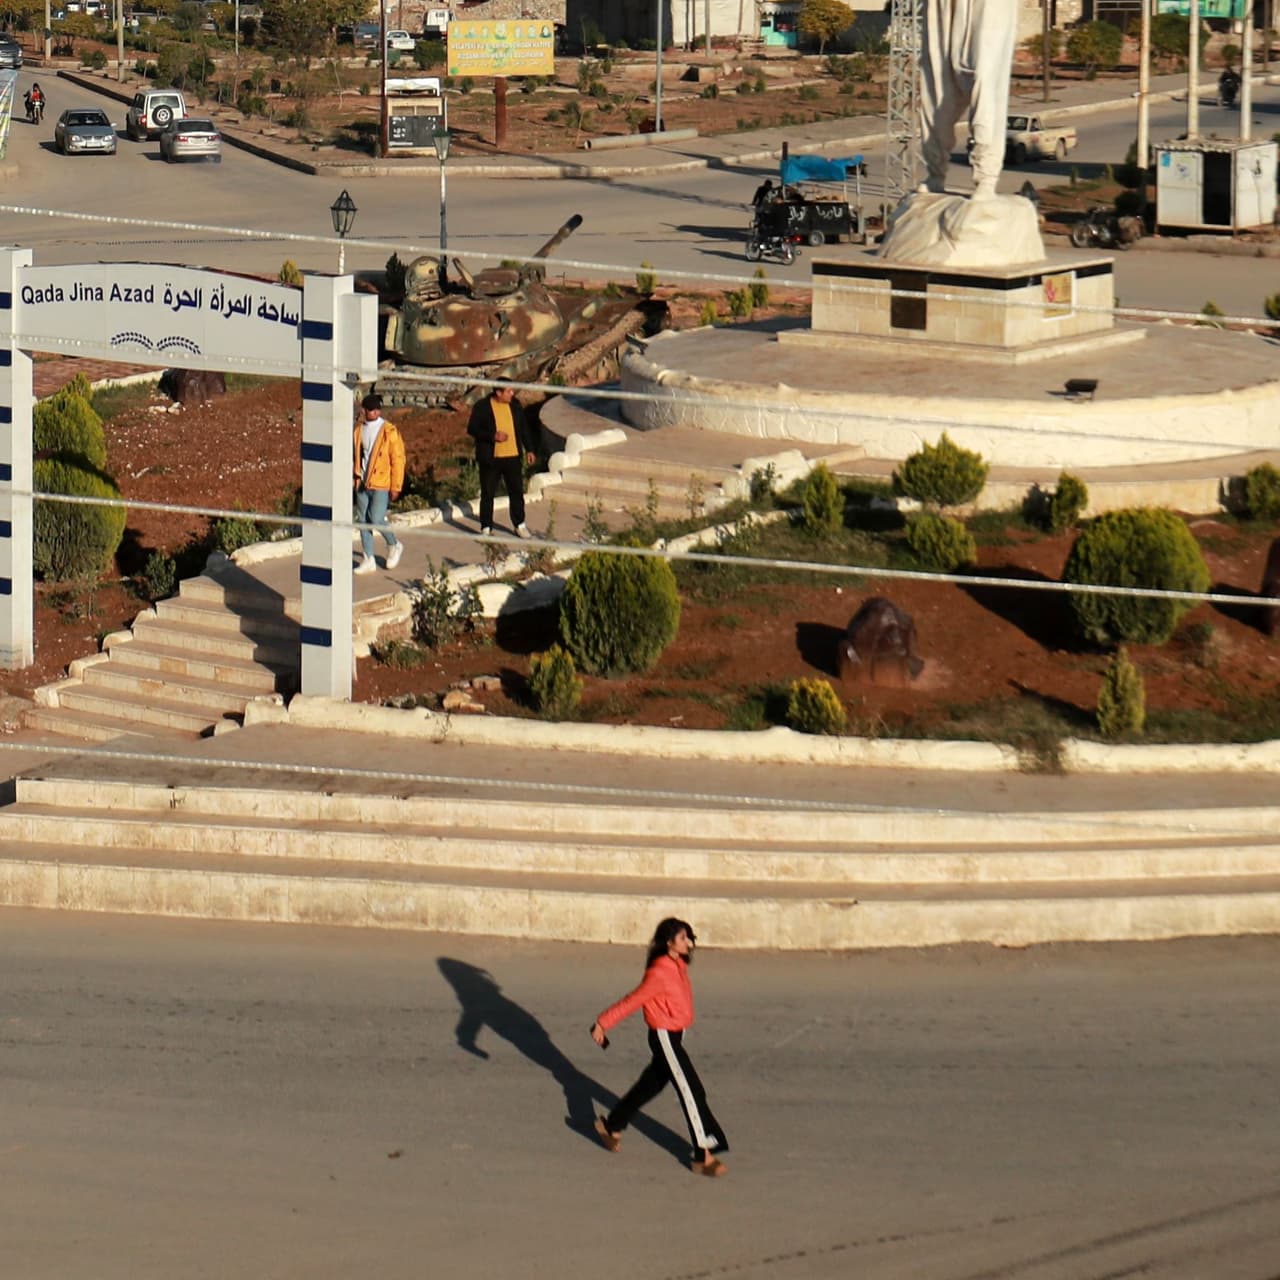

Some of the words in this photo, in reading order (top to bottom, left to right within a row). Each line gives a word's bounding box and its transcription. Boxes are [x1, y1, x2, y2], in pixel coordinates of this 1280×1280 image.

[21, 283, 64, 304] Qada
[69, 282, 104, 302] Jina
[109, 282, 154, 303] Azad
[163, 282, 202, 312] الحرة
[210, 282, 252, 319] المرأة
[257, 296, 299, 327] ساحة
